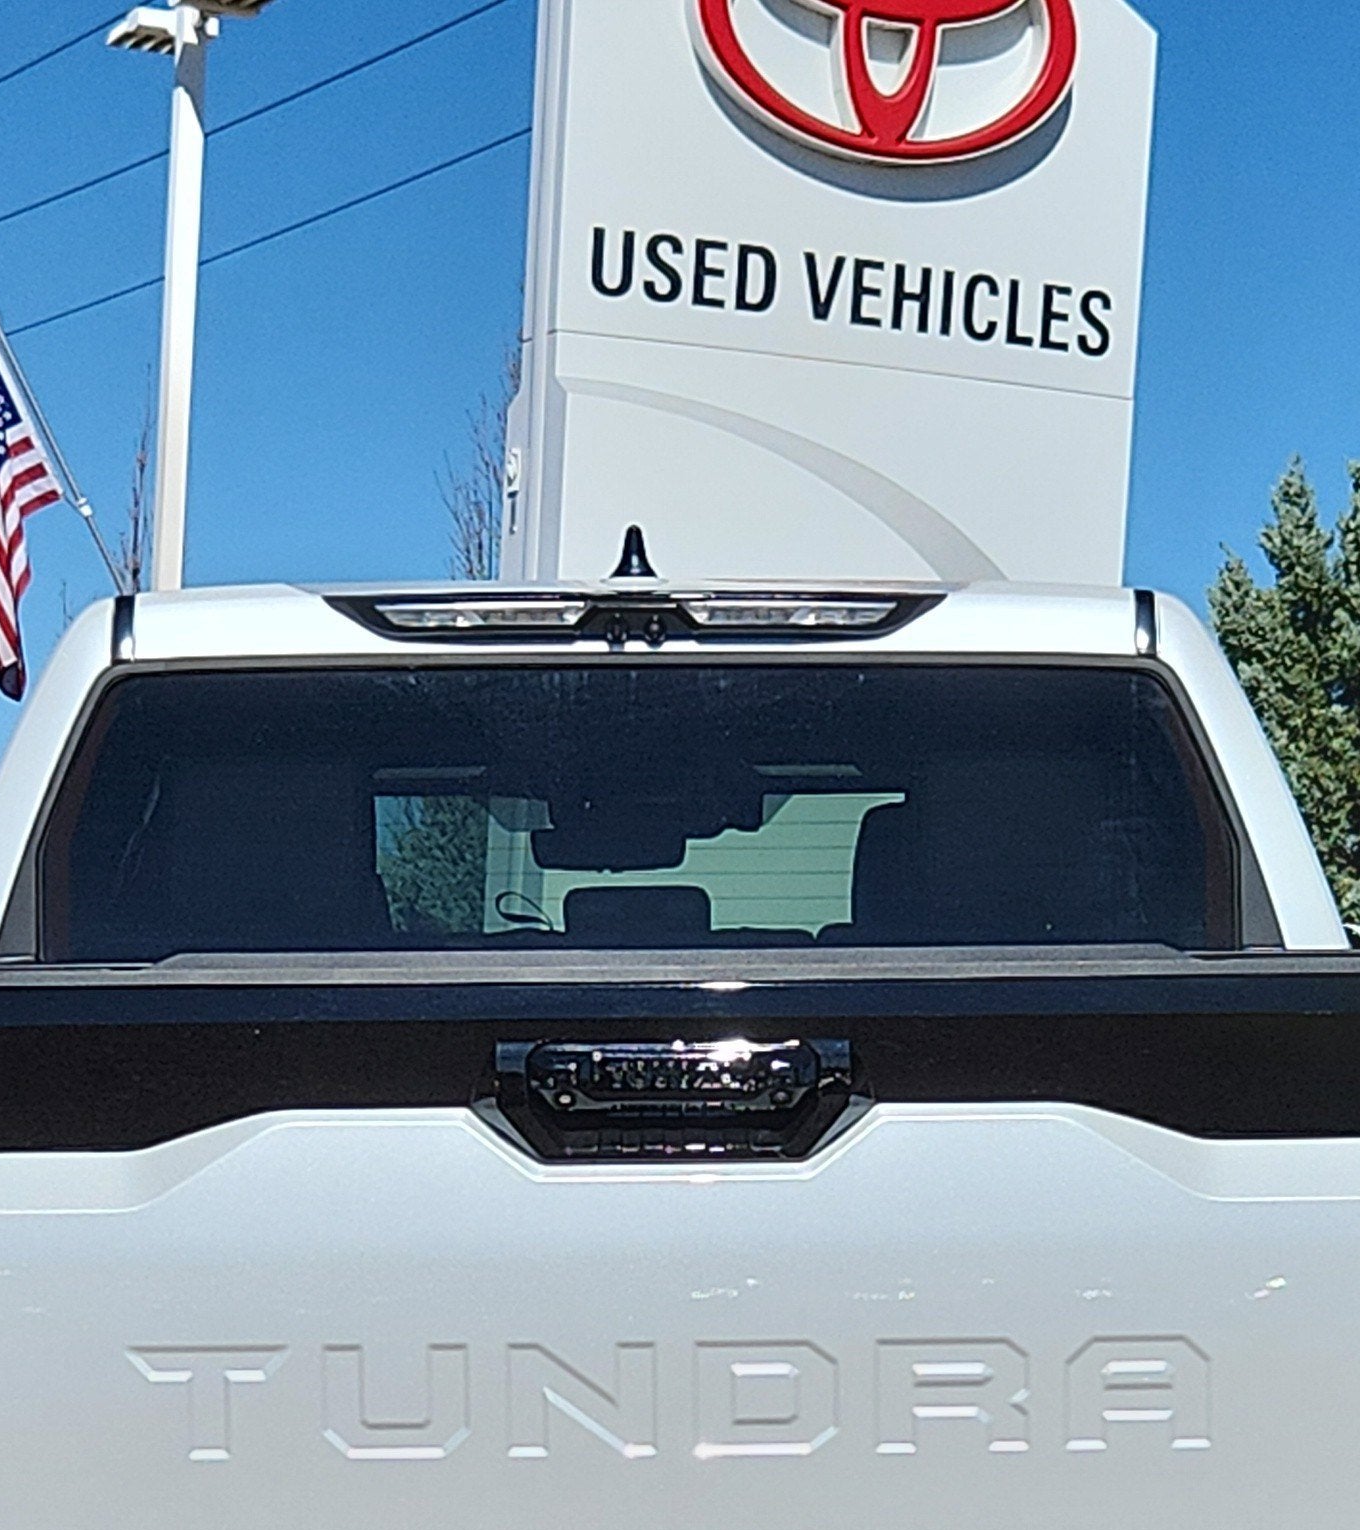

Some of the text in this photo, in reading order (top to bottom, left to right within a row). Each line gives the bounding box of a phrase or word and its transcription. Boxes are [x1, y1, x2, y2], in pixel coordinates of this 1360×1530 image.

[591, 227, 1113, 357] USED VEHICLES
[124, 1335, 1213, 1461] TUNDRA
